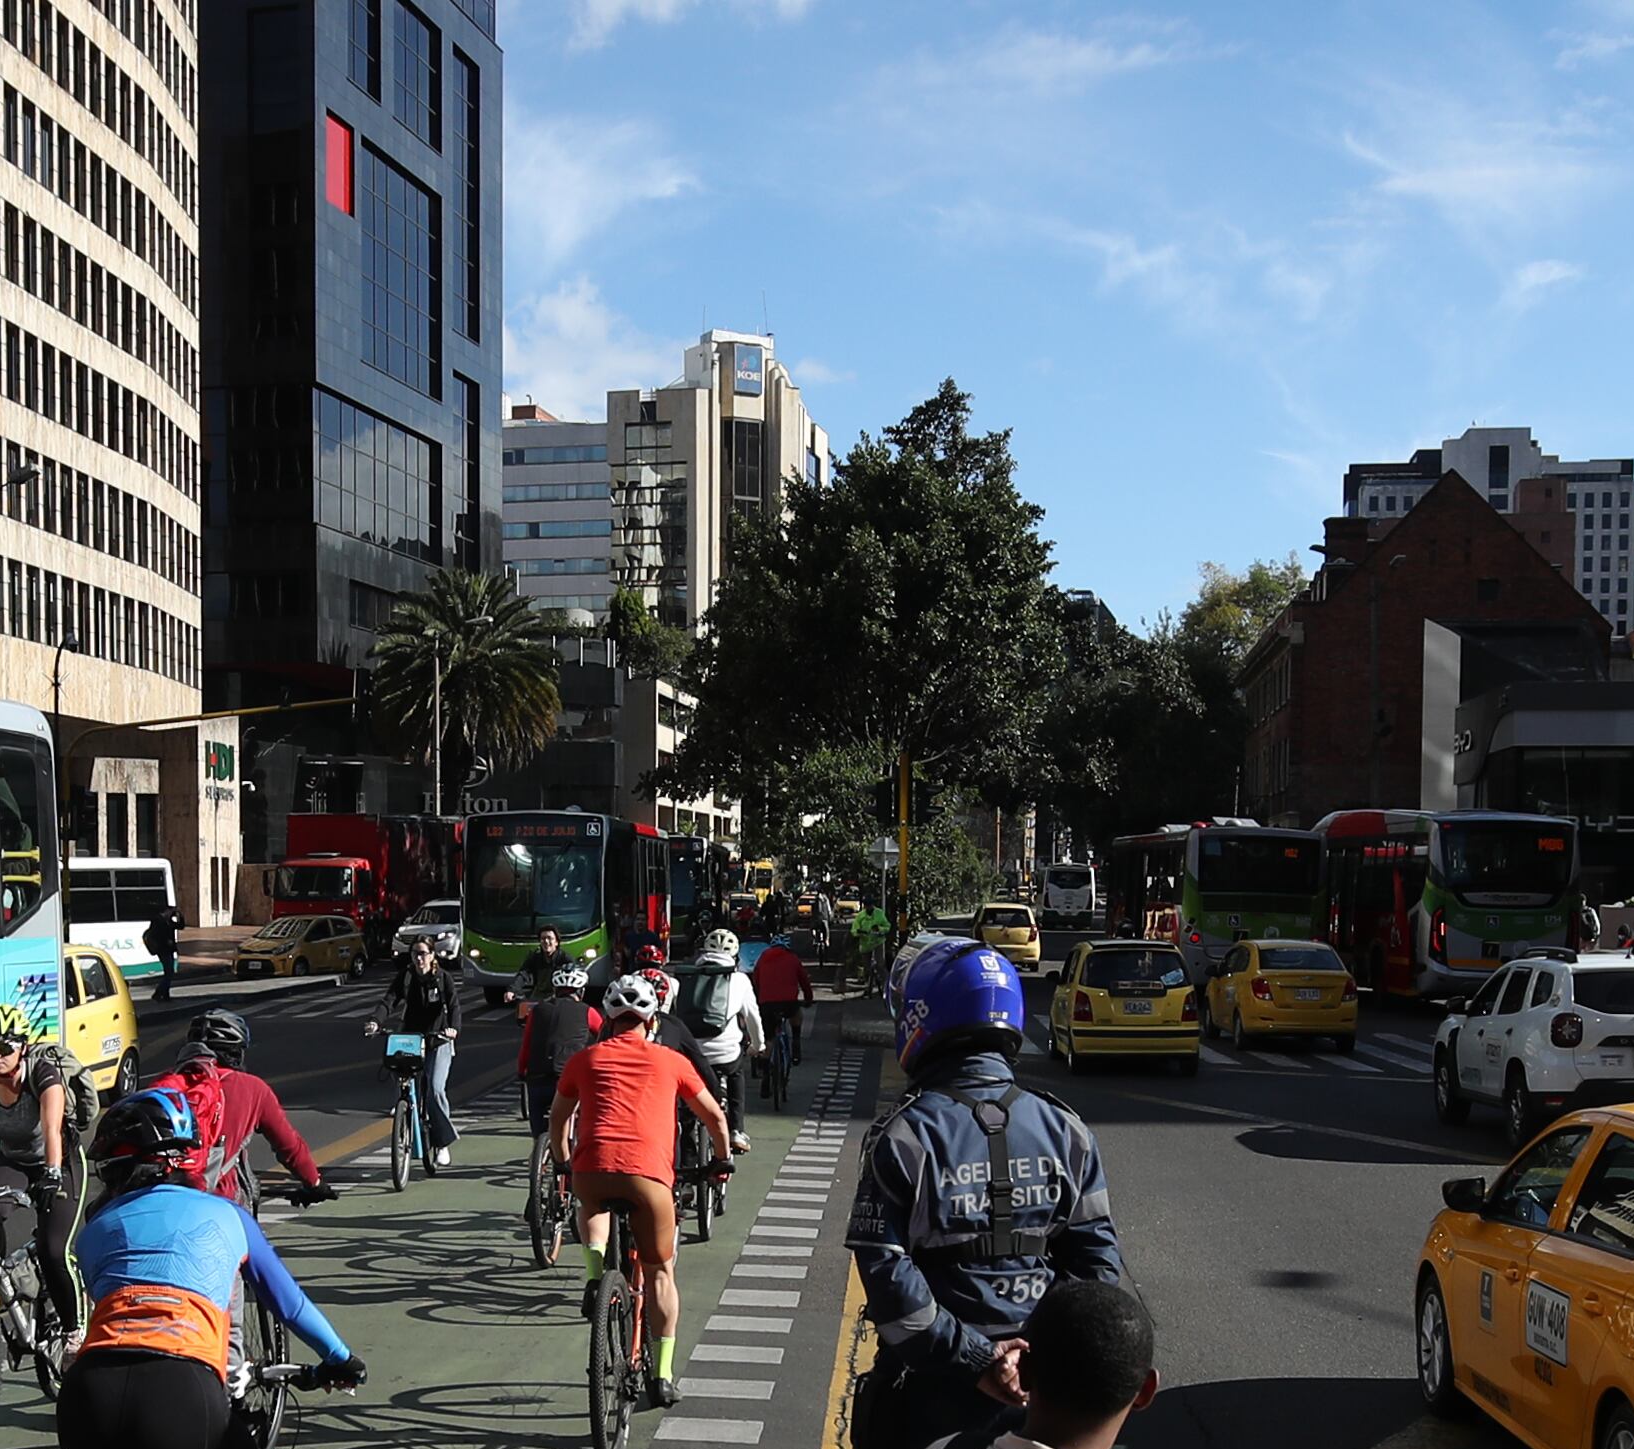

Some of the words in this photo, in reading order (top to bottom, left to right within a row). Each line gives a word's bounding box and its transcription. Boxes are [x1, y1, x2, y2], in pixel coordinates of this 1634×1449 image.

[736, 370, 762, 382] KOE
[204, 740, 235, 783] HDI
[422, 791, 509, 814] Hton
[99, 938, 135, 950] S.A.S.
[900, 998, 930, 1040] 258
[939, 1157, 1031, 1188] AGETE
[1038, 1156, 1067, 1178] DE
[876, 1202, 885, 1217] Y
[991, 1270, 1048, 1305] 258
